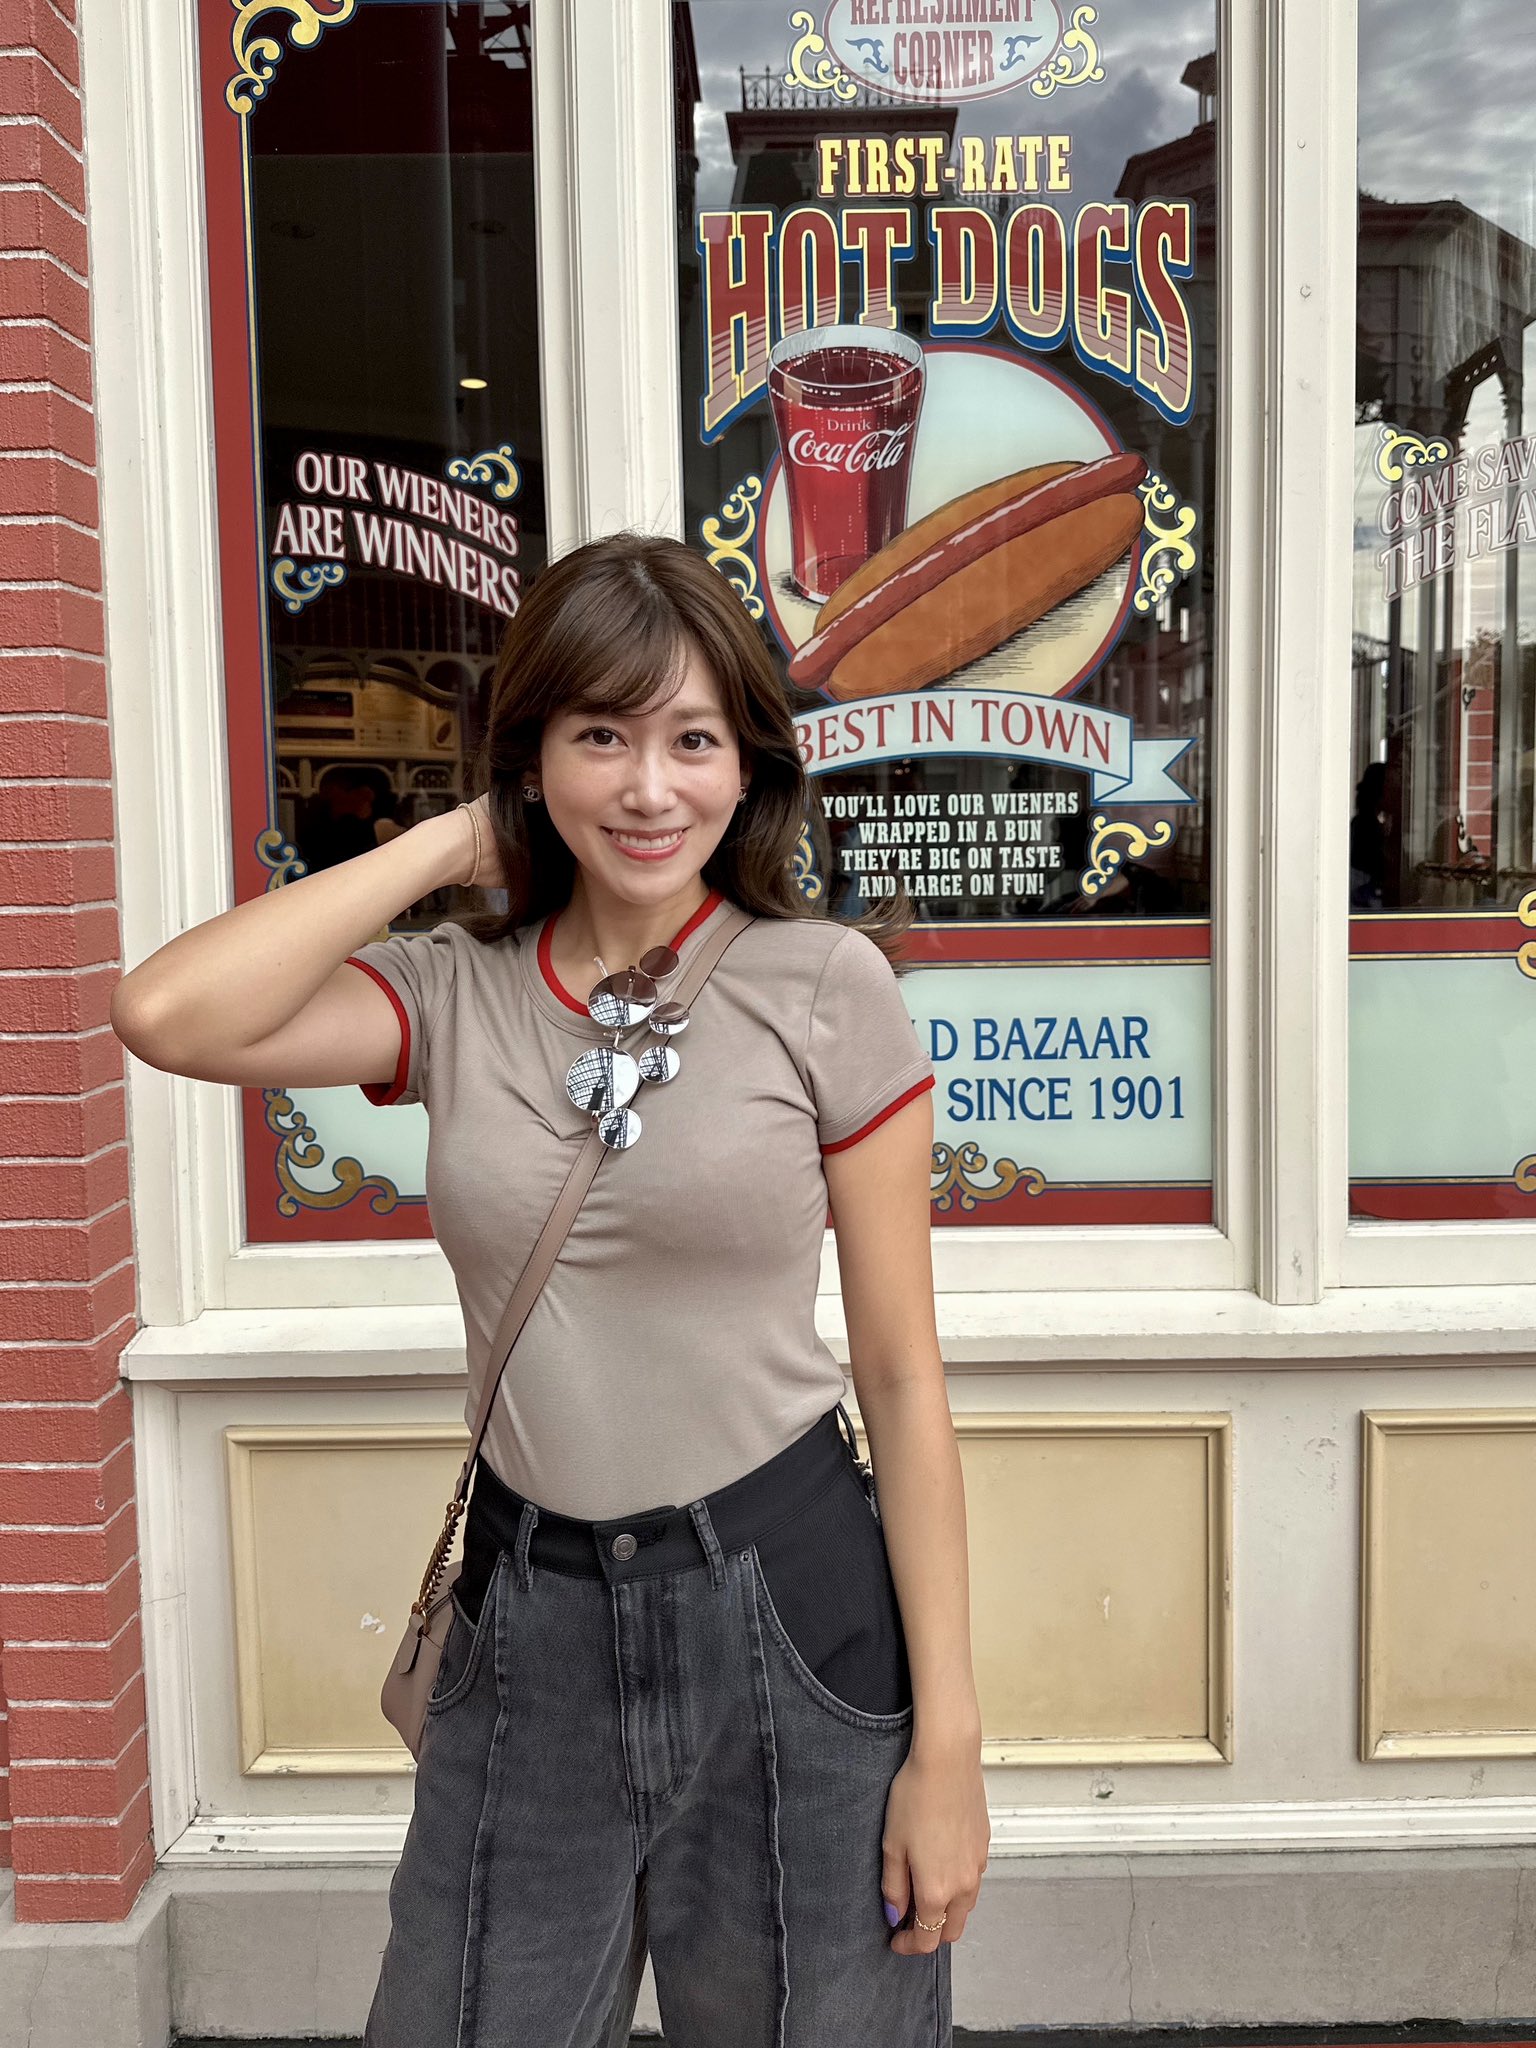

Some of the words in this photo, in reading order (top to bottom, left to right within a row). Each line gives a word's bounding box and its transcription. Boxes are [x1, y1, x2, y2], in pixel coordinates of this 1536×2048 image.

[850, 0, 1034, 25] REFRESHMENT
[893, 30, 995, 90] CORNER
[817, 134, 1072, 196] FIRST-RATE
[698, 208, 914, 441] HOT
[929, 203, 1194, 420] DOGS
[788, 421, 916, 474] Coca-Cola
[827, 418, 872, 432] Drink
[296, 451, 373, 501] OUR
[373, 462, 518, 557] WIENERS
[1381, 457, 1470, 537] COME
[1476, 437, 1536, 493] SAV
[271, 503, 346, 559] ARE
[351, 510, 520, 619] WINNERS
[1379, 514, 1456, 599] THE
[1466, 486, 1536, 560] FLA
[793, 703, 895, 766] BEST
[910, 699, 955, 743] IN
[971, 699, 1111, 765] TOWN
[821, 796, 888, 819] YOU'LL
[893, 795, 941, 818] LOVE
[947, 794, 985, 816] OUR
[991, 791, 1079, 815] WIENERS
[858, 821, 951, 845] WRAPPED
[957, 821, 978, 843] IN
[984, 821, 999, 843] A
[1004, 819, 1043, 842] BUN
[841, 848, 923, 872] THEY'RE
[928, 847, 961, 870] BIG
[967, 847, 993, 869] ON
[998, 846, 1061, 869] TASTE
[858, 875, 897, 898] AND
[903, 874, 964, 897] LARGE
[969, 873, 996, 896] ON
[1001, 872, 1045, 896] FUN!
[973, 1016, 1151, 1061] BAZAAR
[946, 1077, 1073, 1122] SINCE
[1089, 1075, 1185, 1120] 1901
